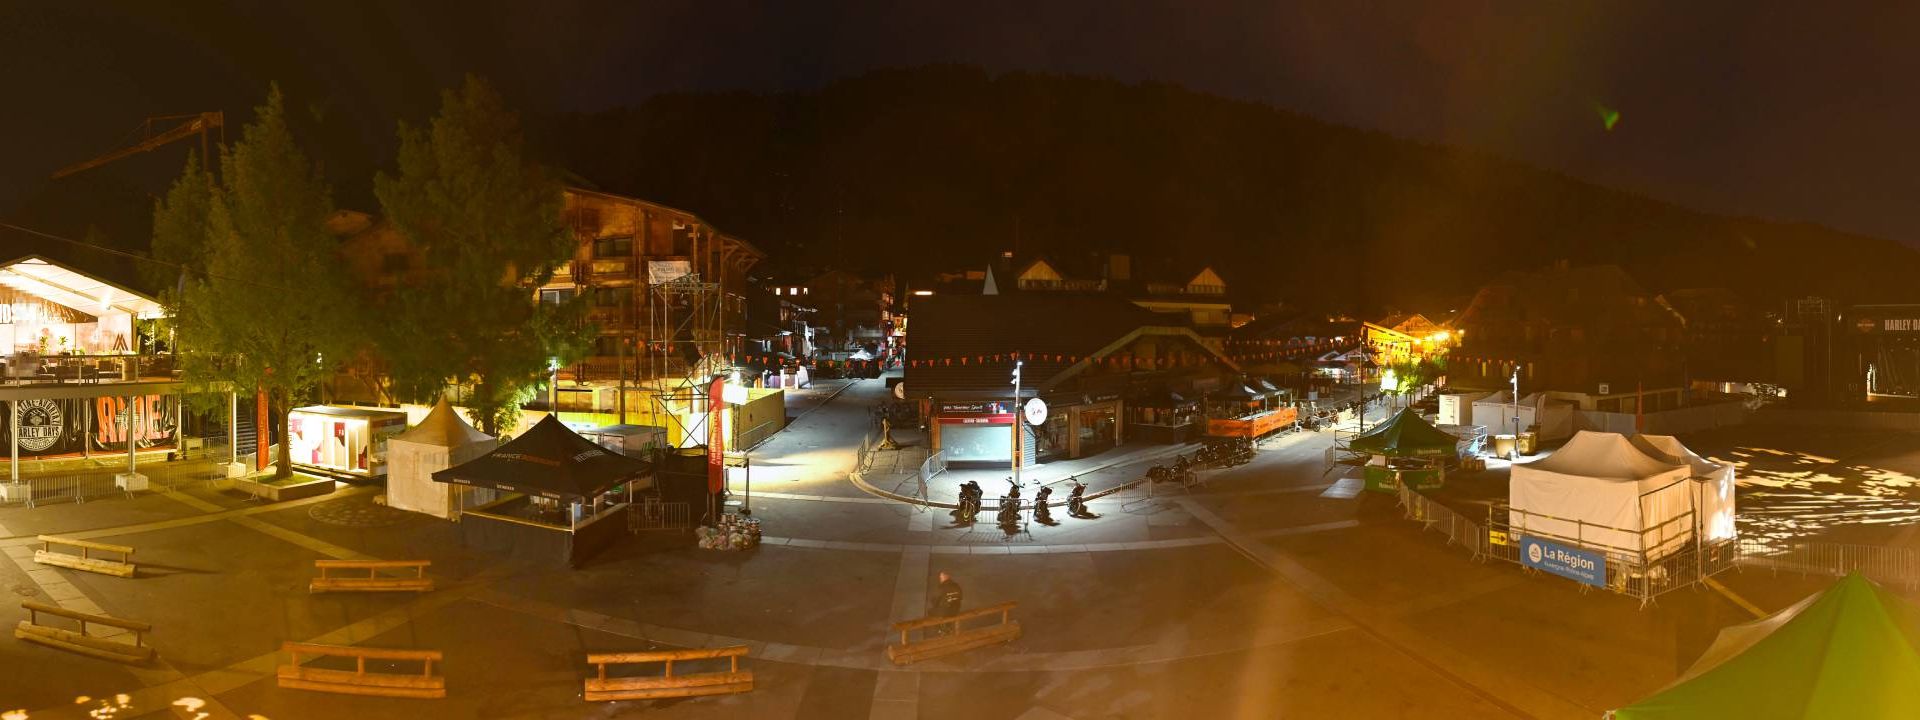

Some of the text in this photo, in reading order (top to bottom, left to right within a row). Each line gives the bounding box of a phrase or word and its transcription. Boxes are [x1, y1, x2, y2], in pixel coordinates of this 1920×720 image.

[1884, 319, 1911, 331] HARLEY
[18, 427, 39, 438] ARLEY
[1544, 546, 1594, 571] La Région
